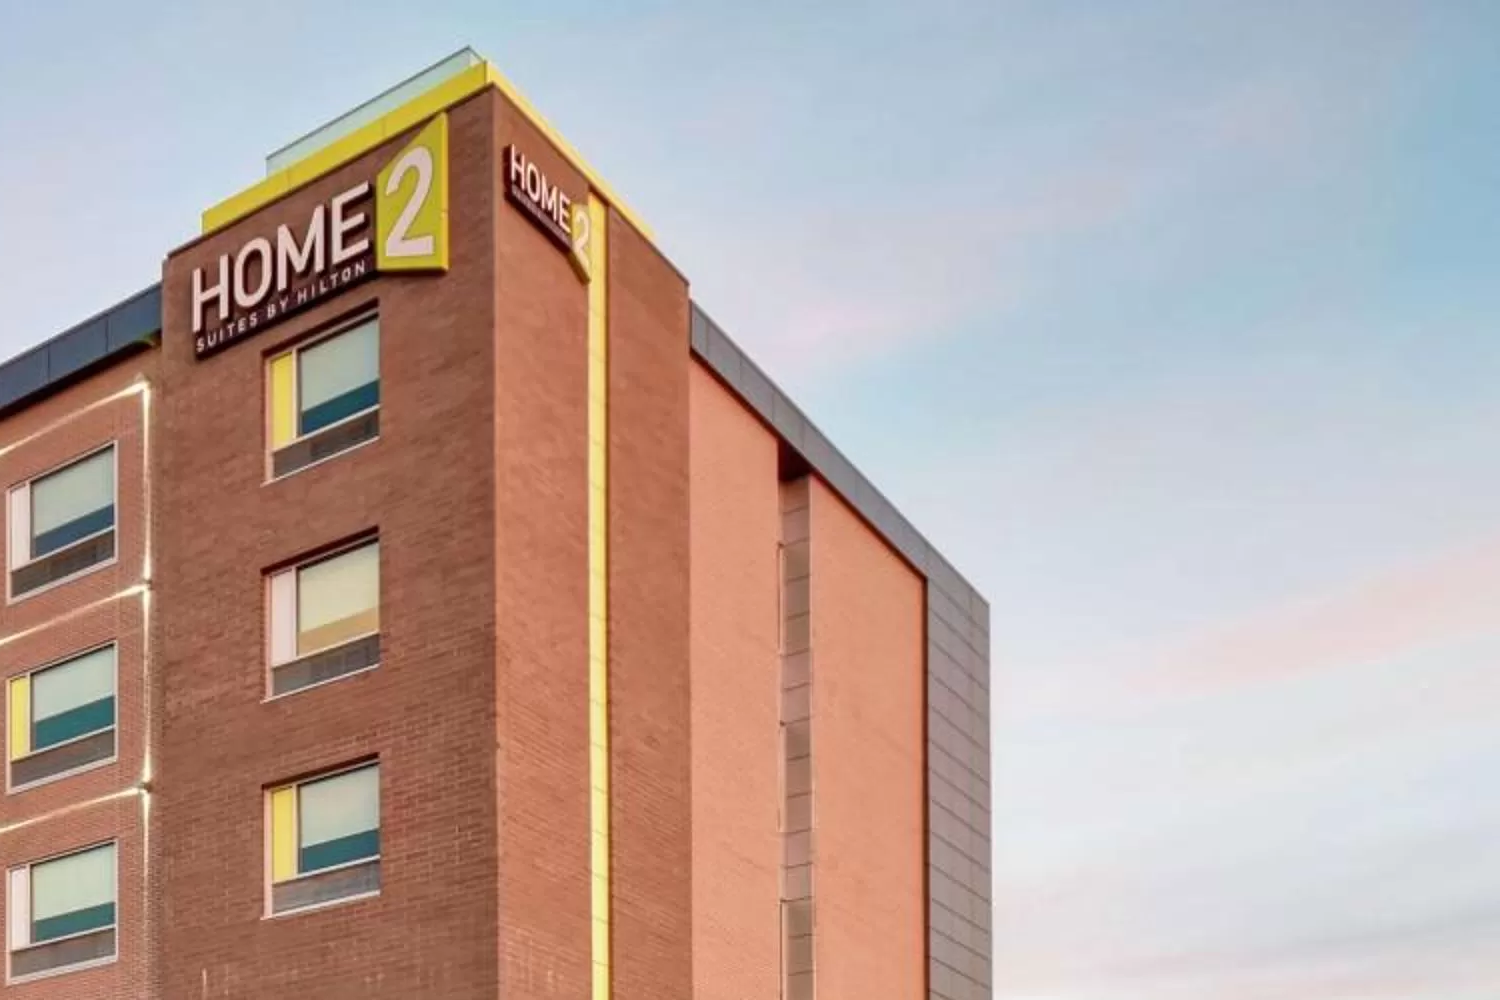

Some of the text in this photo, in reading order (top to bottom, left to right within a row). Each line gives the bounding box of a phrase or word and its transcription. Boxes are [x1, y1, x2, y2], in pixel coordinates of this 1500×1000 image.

[192, 180, 370, 333] HOME
[385, 146, 434, 257] 2
[510, 143, 572, 234] HOME
[572, 209, 590, 275] 2
[196, 259, 366, 353] SUITES BY HILTON
